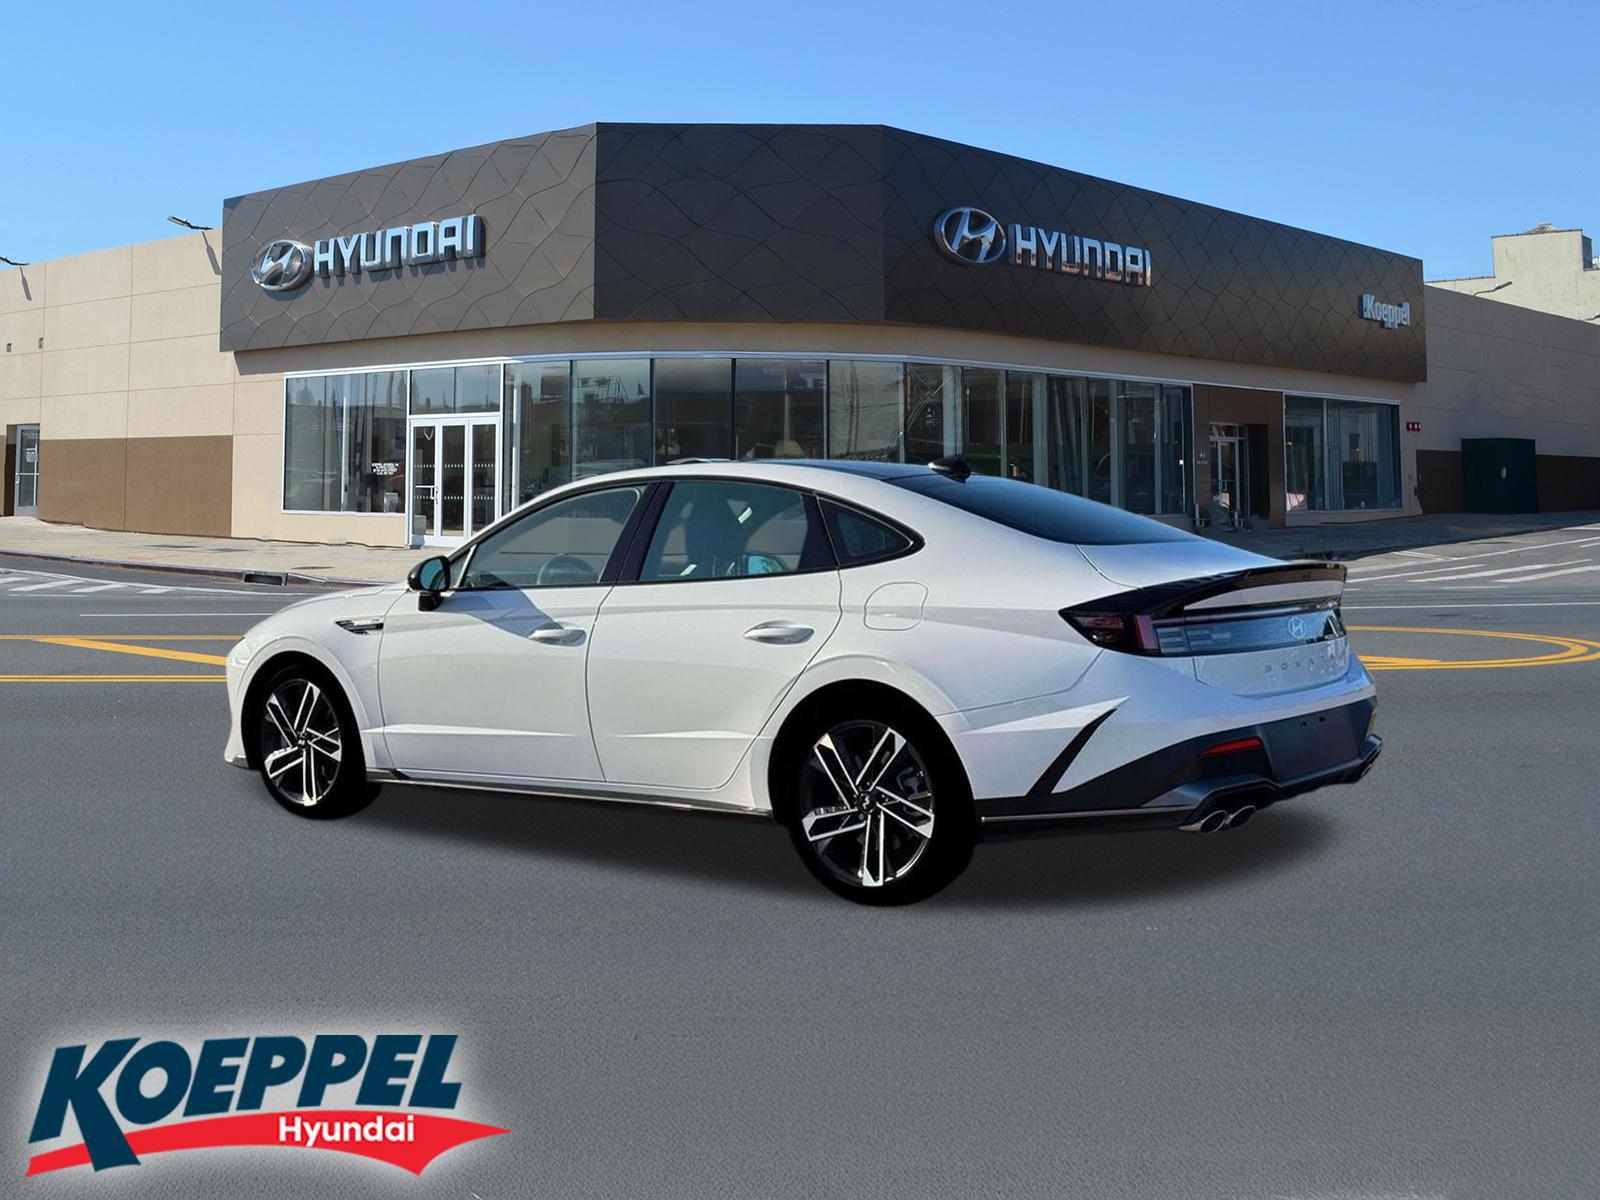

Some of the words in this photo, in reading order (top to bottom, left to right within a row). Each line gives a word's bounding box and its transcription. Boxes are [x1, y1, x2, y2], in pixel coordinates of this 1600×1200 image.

[314, 213, 484, 279] HYUNDAI
[1012, 223, 1152, 287] HYUNDAI
[1361, 293, 1411, 329] Koeppel
